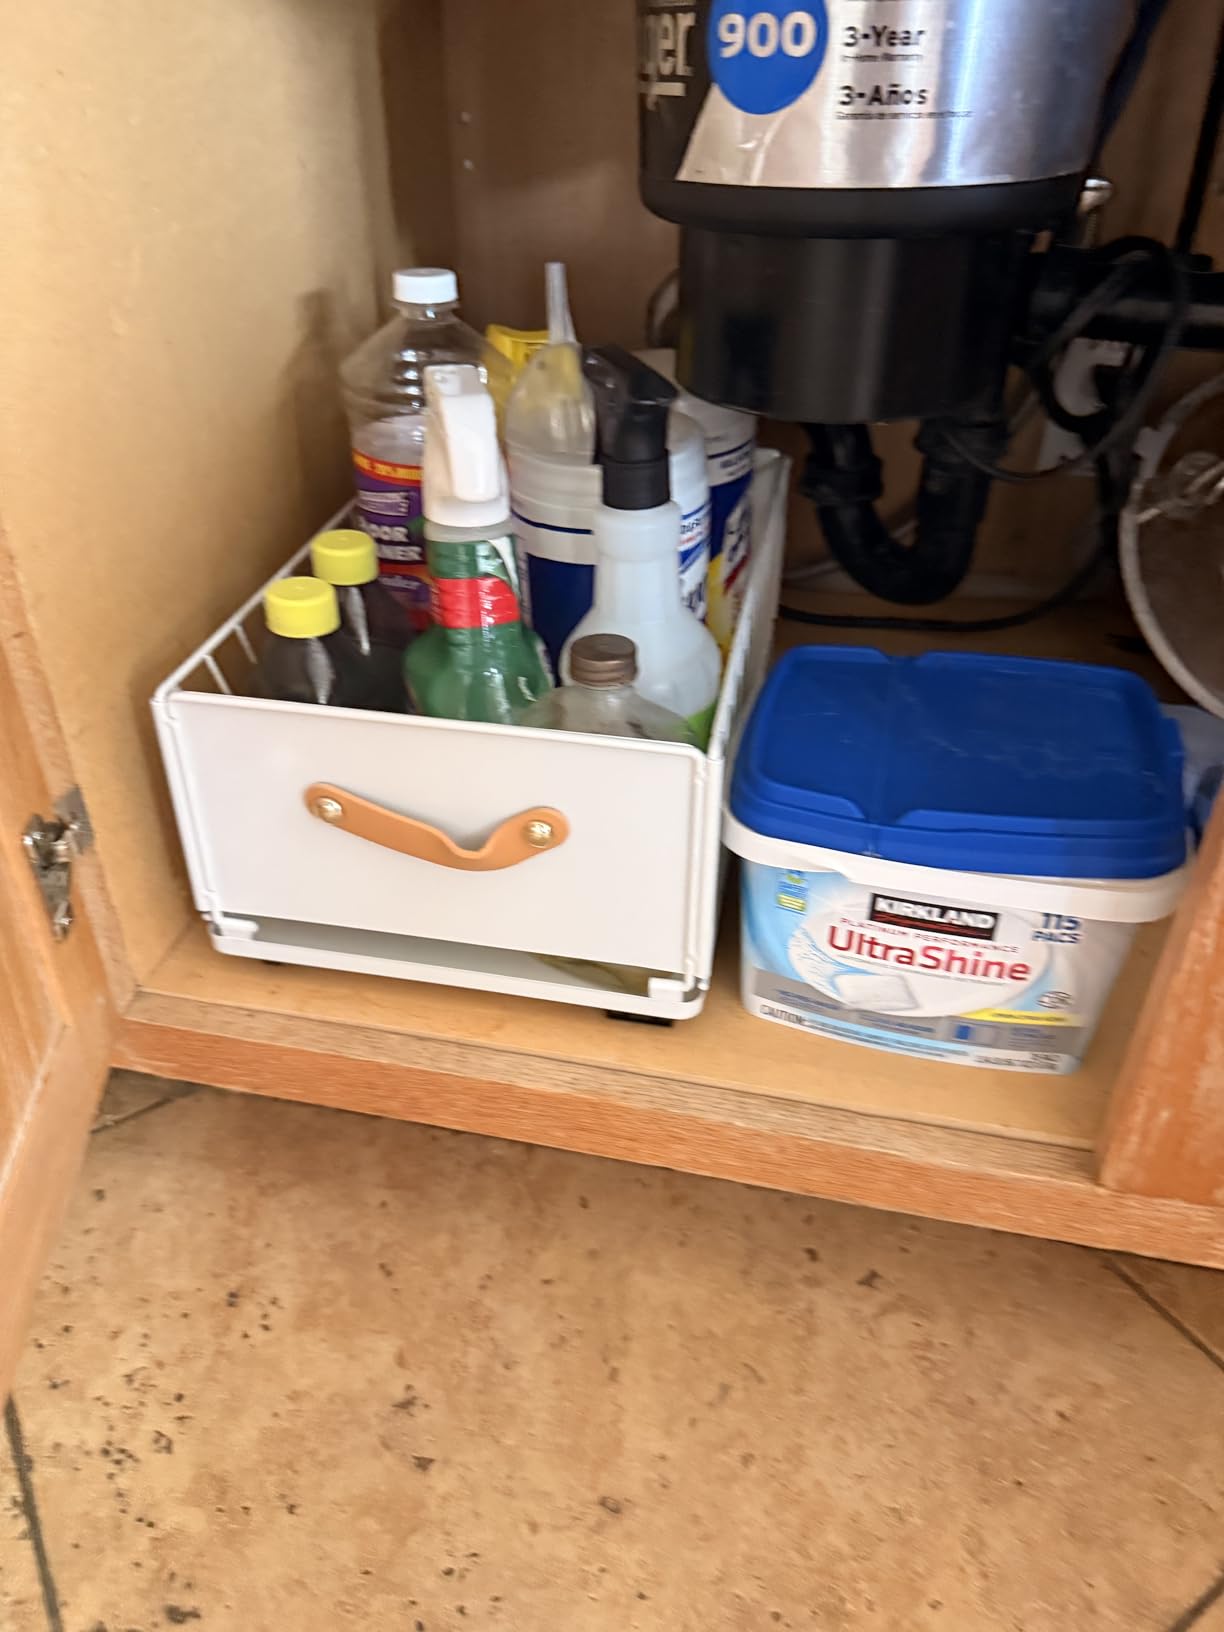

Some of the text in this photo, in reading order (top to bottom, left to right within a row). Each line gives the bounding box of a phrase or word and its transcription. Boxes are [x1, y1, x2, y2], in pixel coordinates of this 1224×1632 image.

[717, 11, 817, 58] 900
[843, 25, 926, 47] 3-Year
[838, 83, 928, 106] 3-Años
[875, 897, 996, 930] KIRKLAND
[1042, 912, 1081, 931] 115
[840, 917, 1019, 954] PLATINUM PERFORMANCE
[1032, 930, 1082, 945] PACS
[827, 925, 1032, 981] UltraShine
